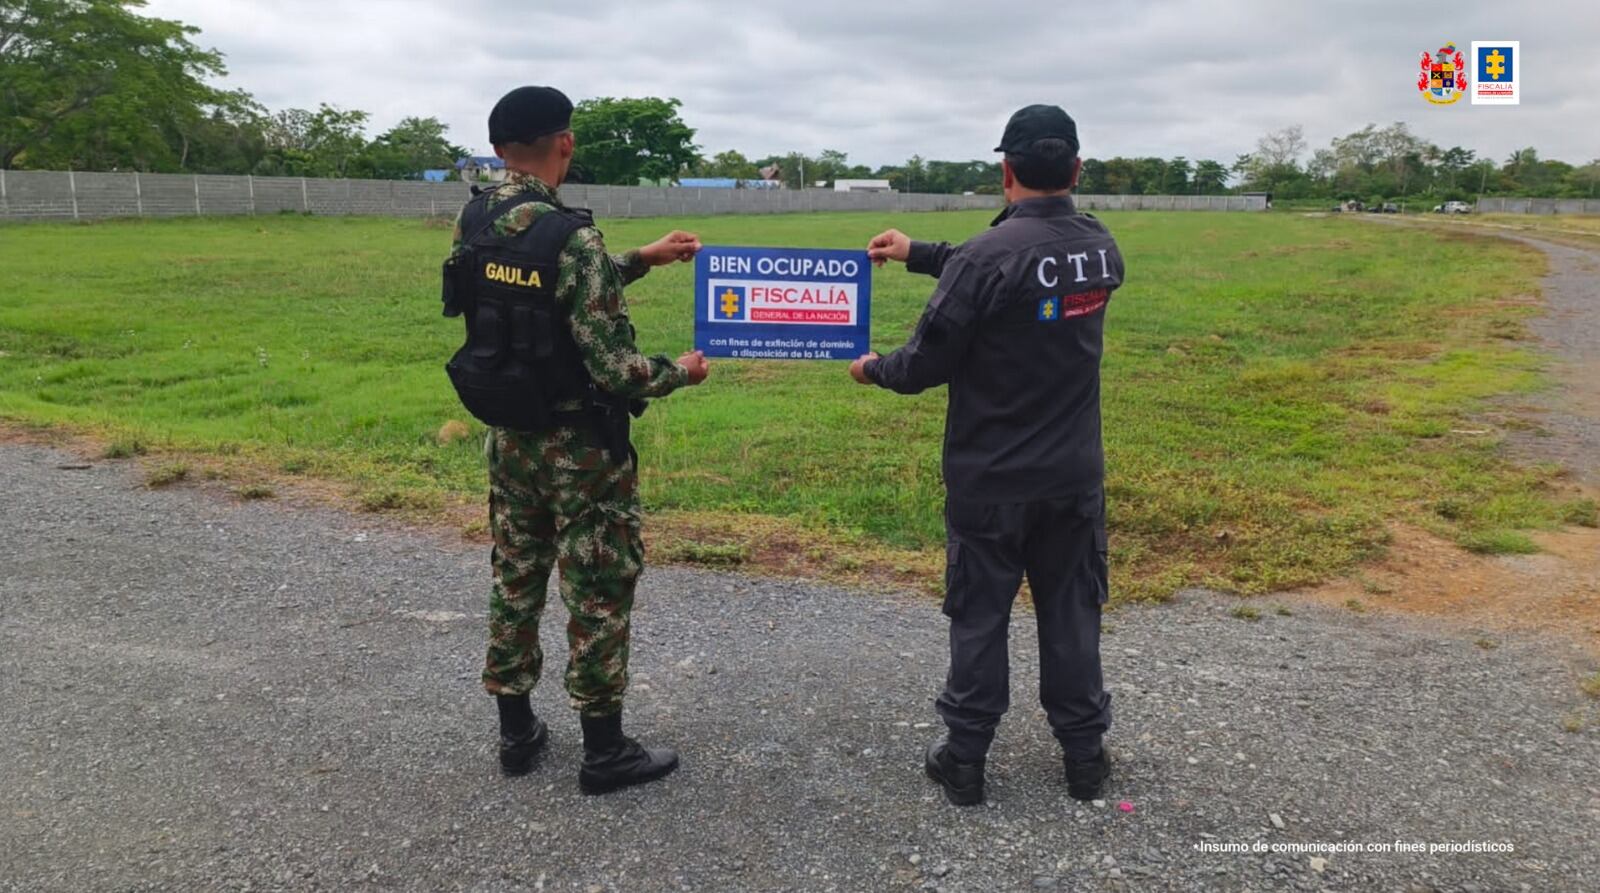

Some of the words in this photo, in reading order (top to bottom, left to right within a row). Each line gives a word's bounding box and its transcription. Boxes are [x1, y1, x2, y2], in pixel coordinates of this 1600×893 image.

[709, 256, 751, 273] BIEN
[757, 257, 858, 277] OCUPADO
[485, 262, 542, 288] GAULA
[751, 286, 849, 305] FISCALÍA
[753, 311, 789, 320] GENERAL
[793, 312, 804, 320] DE
[806, 312, 816, 320] LA
[816, 312, 848, 321] NACIÓN
[729, 338, 748, 346] fines
[751, 338, 763, 347] de
[806, 339, 818, 348] de
[820, 340, 855, 349] dominio
[740, 349, 789, 358] disposición
[790, 349, 802, 358] de
